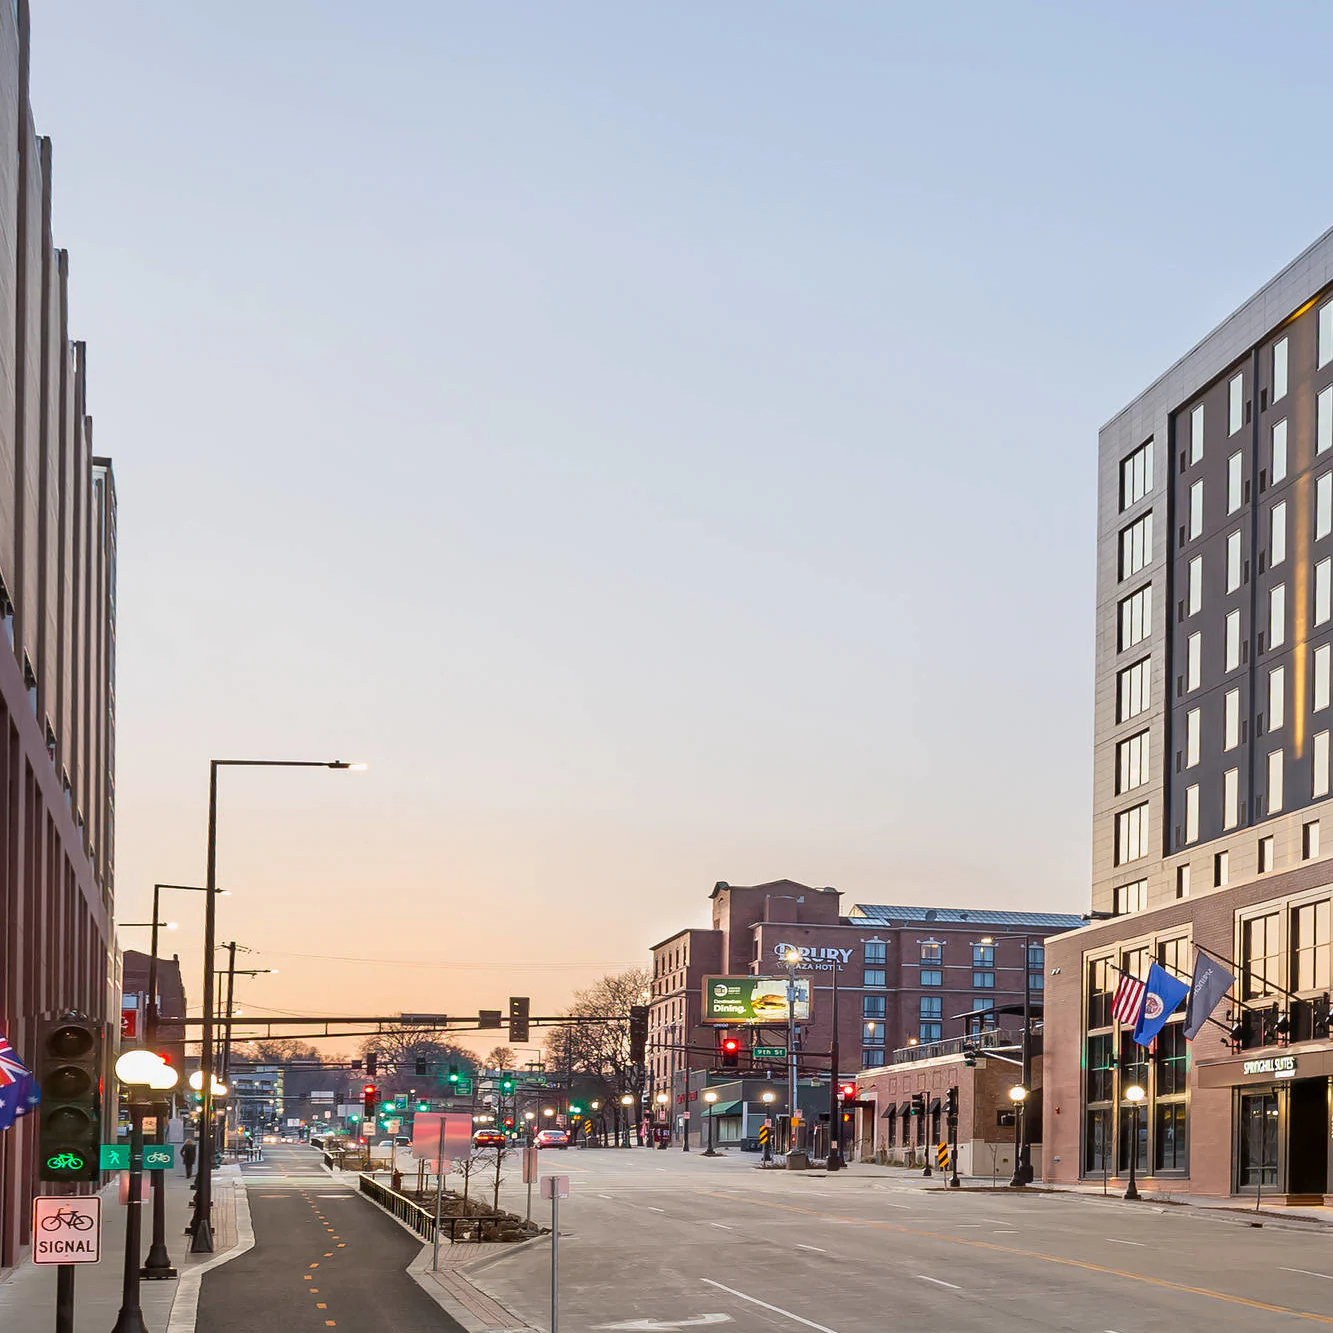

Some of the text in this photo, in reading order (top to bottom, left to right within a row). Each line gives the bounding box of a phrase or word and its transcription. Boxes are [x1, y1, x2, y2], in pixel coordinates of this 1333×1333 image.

[774, 942, 854, 964] DRURY
[815, 963, 844, 971] HOTL
[39, 1240, 95, 1253] SIGNAL
